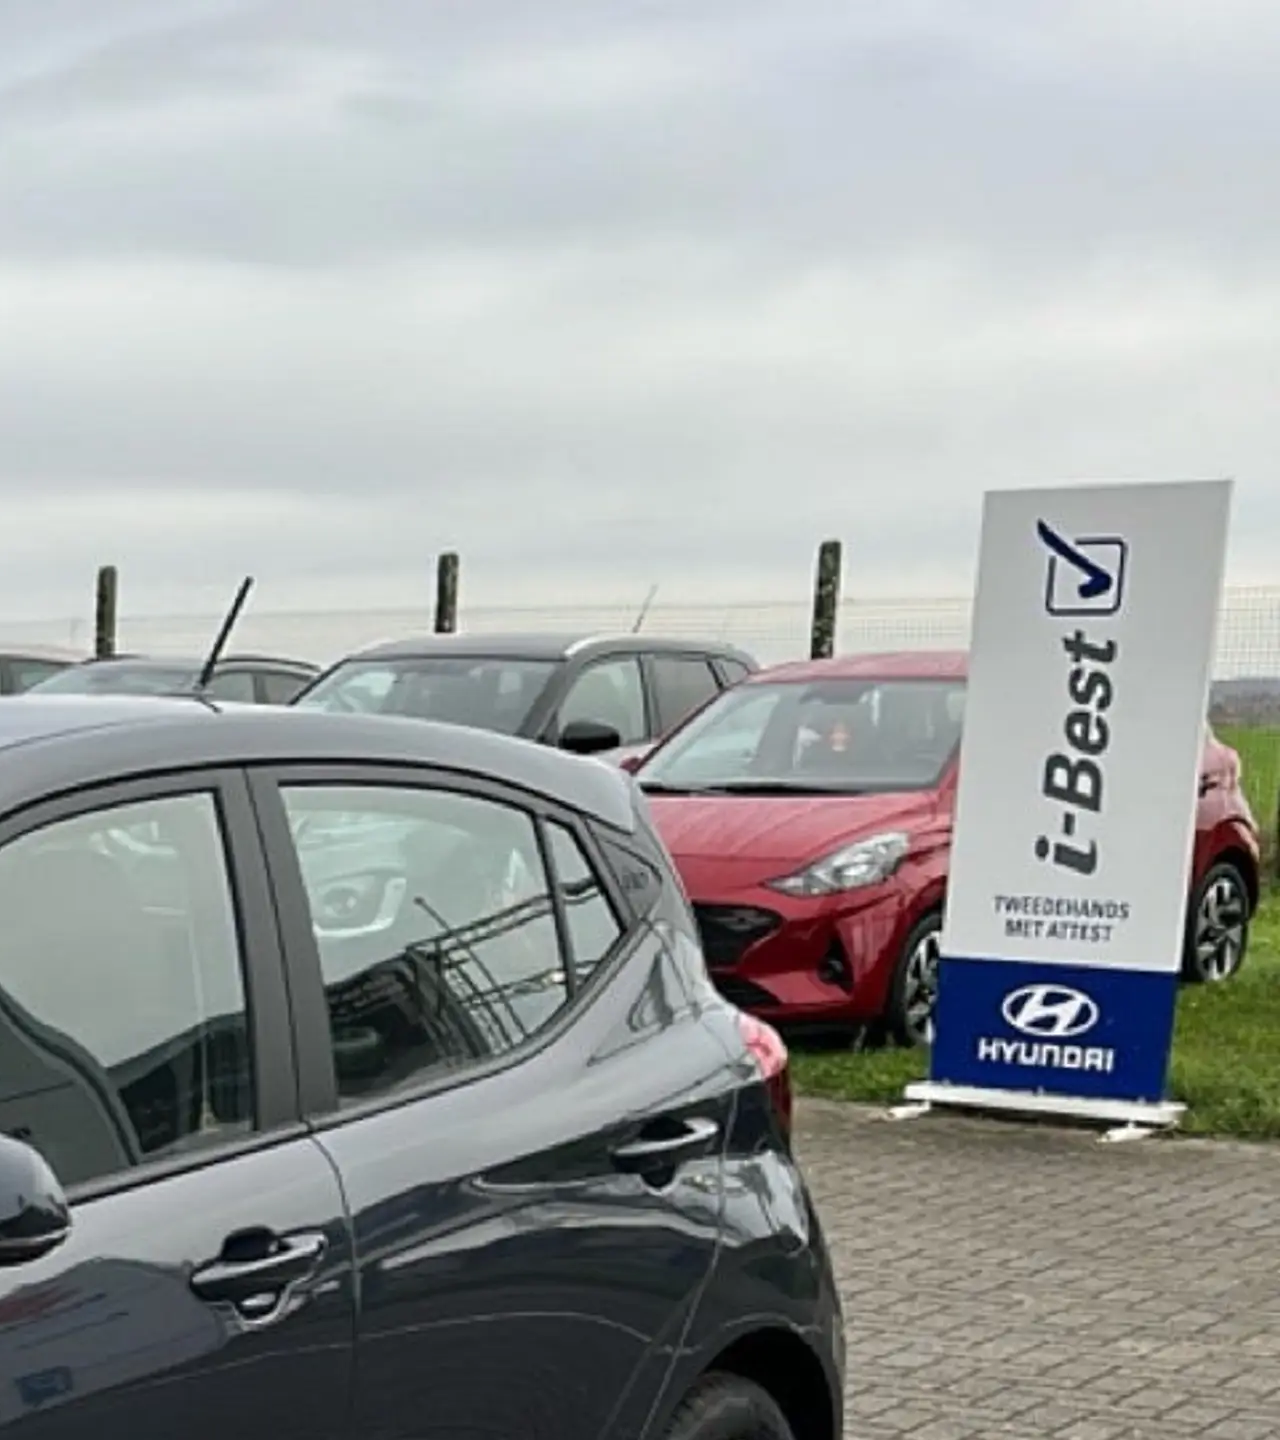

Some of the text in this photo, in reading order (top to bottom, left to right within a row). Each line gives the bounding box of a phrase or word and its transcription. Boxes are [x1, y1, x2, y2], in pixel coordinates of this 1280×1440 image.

[1035, 630, 1117, 875] i-Best
[994, 895, 1131, 920] TWEEDEHANDS
[1004, 918, 1113, 943] MET ATTEST
[977, 1036, 1115, 1075] HYUNDAI
